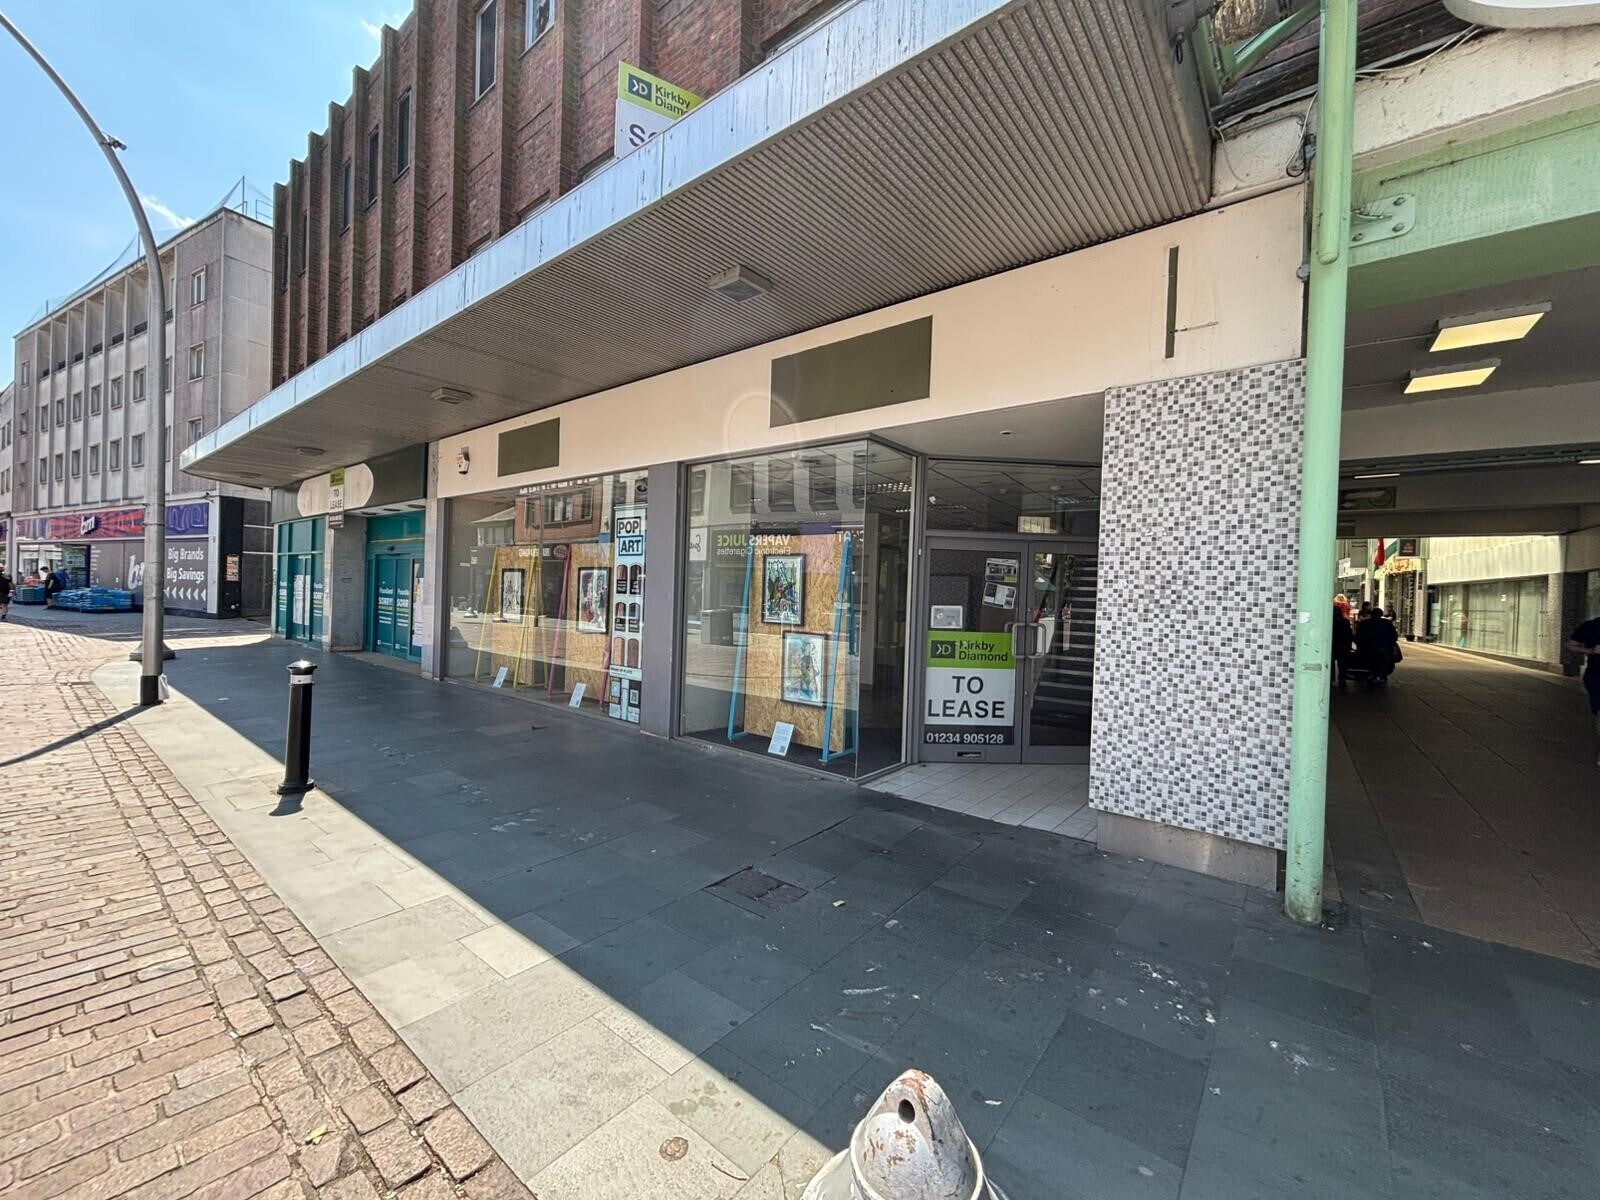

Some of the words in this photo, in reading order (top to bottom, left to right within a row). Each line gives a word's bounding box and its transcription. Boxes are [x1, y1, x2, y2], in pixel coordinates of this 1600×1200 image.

[655, 84, 691, 109] Kirkby
[618, 521, 639, 534] POP
[620, 540, 641, 552] ART
[168, 547, 179, 563] Big
[180, 547, 204, 560] Brands
[166, 566, 178, 583] Big
[178, 567, 205, 584] Savings
[959, 640, 995, 652] Kirkby
[958, 651, 1008, 662] Diamond
[952, 676, 984, 694] TO
[927, 699, 1005, 718] LEASE
[926, 733, 960, 743] 01234
[963, 734, 1004, 744] 905128
